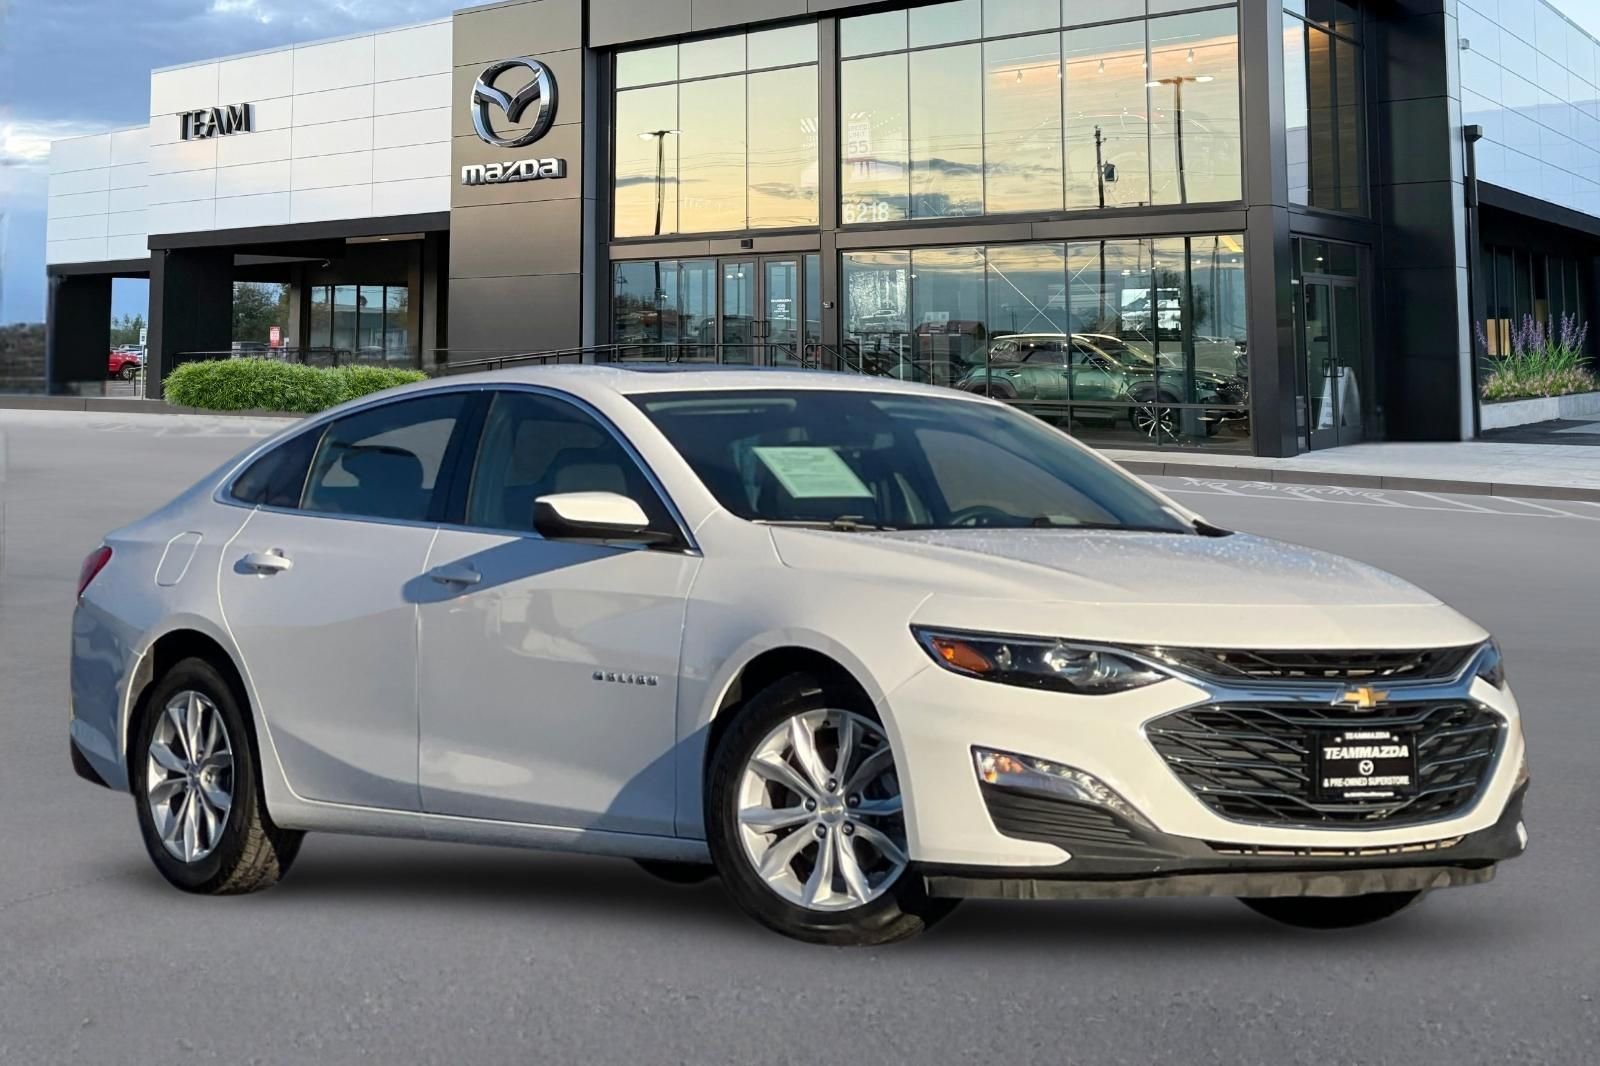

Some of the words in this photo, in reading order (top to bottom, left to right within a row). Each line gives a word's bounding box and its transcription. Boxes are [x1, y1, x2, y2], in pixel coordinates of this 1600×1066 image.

[176, 103, 251, 140] TEAM
[849, 140, 869, 154] 55
[846, 201, 889, 223] 6218
[1183, 479, 1228, 489] NO
[1240, 481, 1386, 498] PARKING
[1323, 745, 1409, 760] TEAMMAZDA
